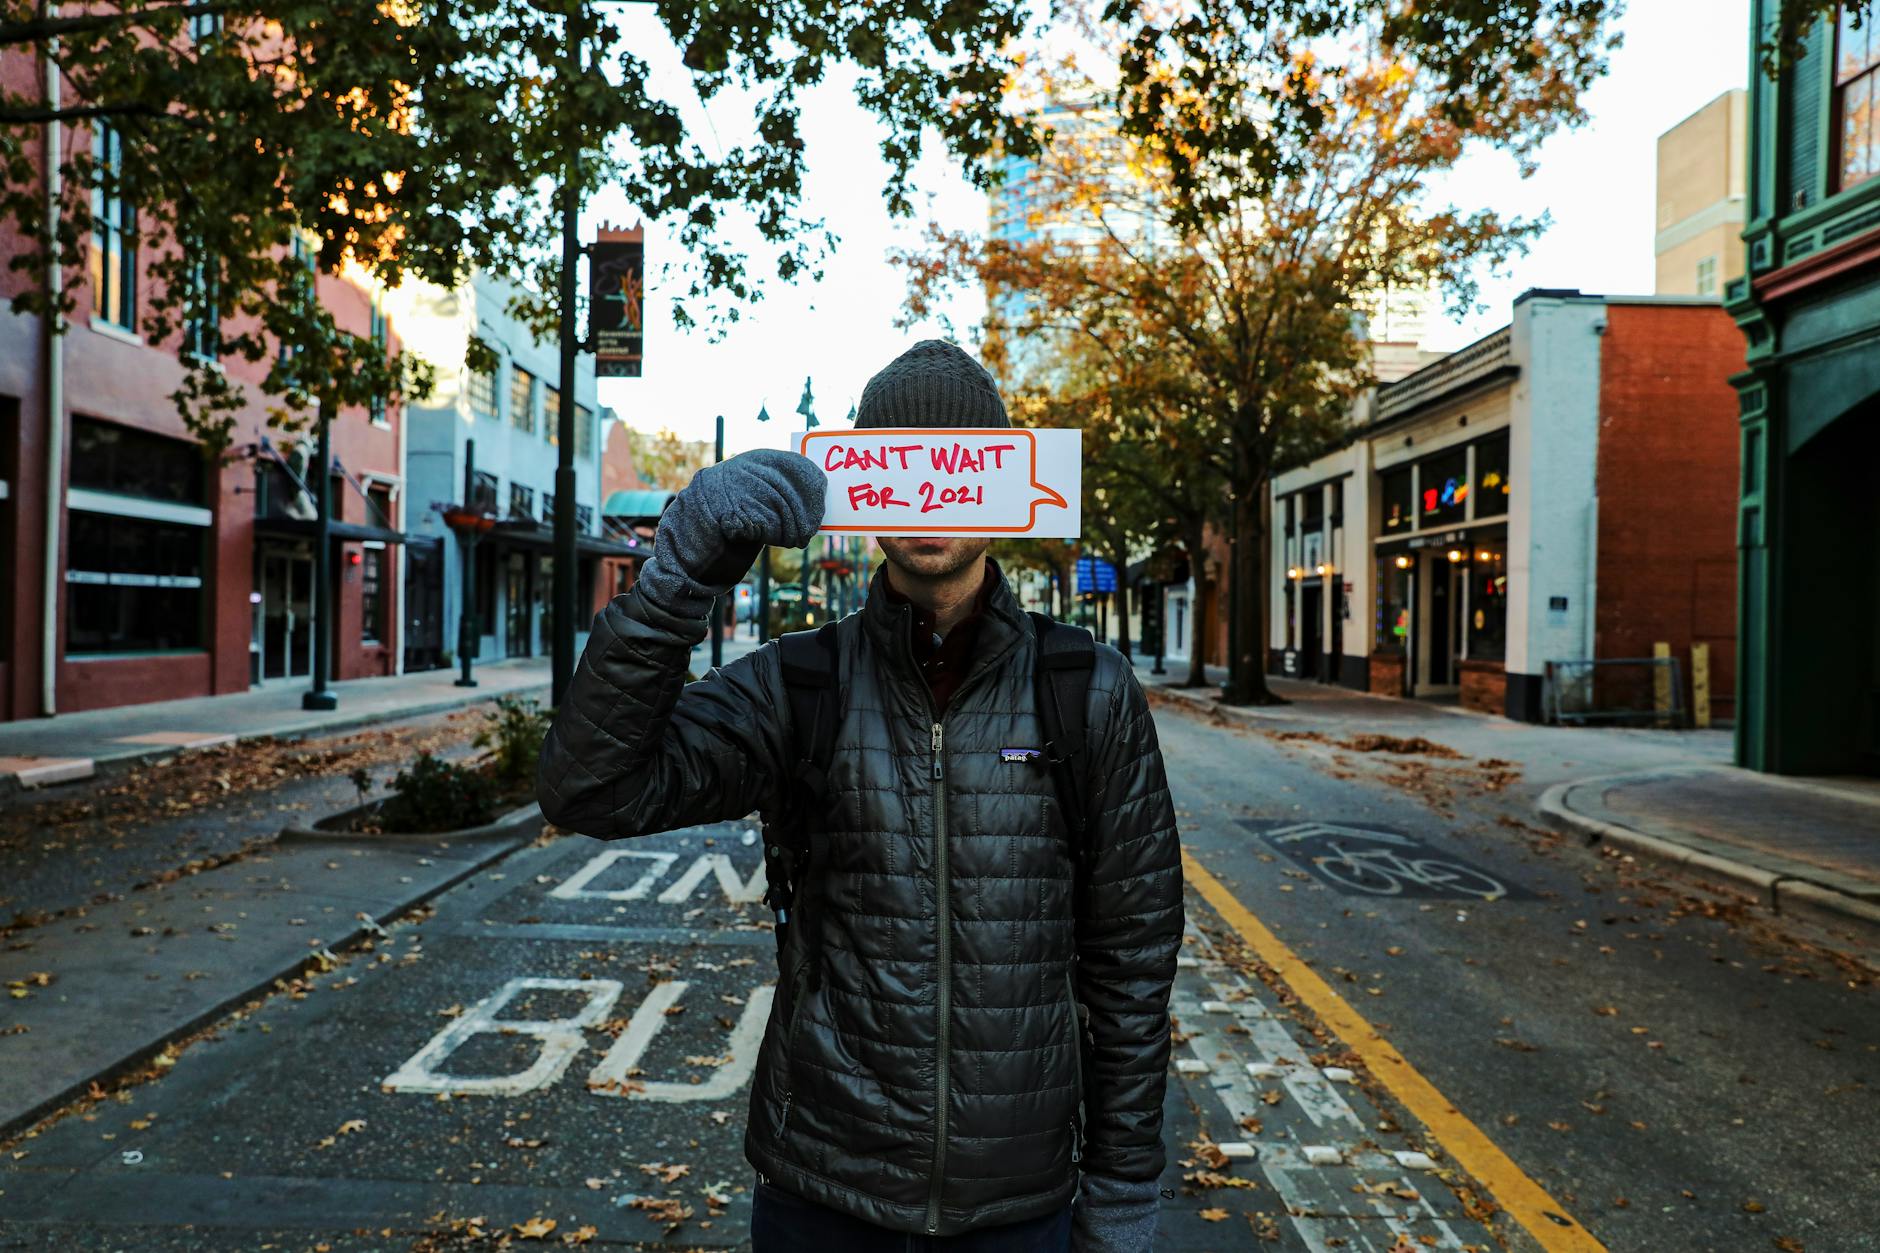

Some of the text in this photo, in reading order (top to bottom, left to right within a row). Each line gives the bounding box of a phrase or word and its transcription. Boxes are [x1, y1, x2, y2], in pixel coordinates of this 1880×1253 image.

[930, 443, 1015, 475] WAIT
[847, 481, 983, 513] FOR 2021
[550, 849, 768, 903] ON
[382, 976, 778, 1103] BU
